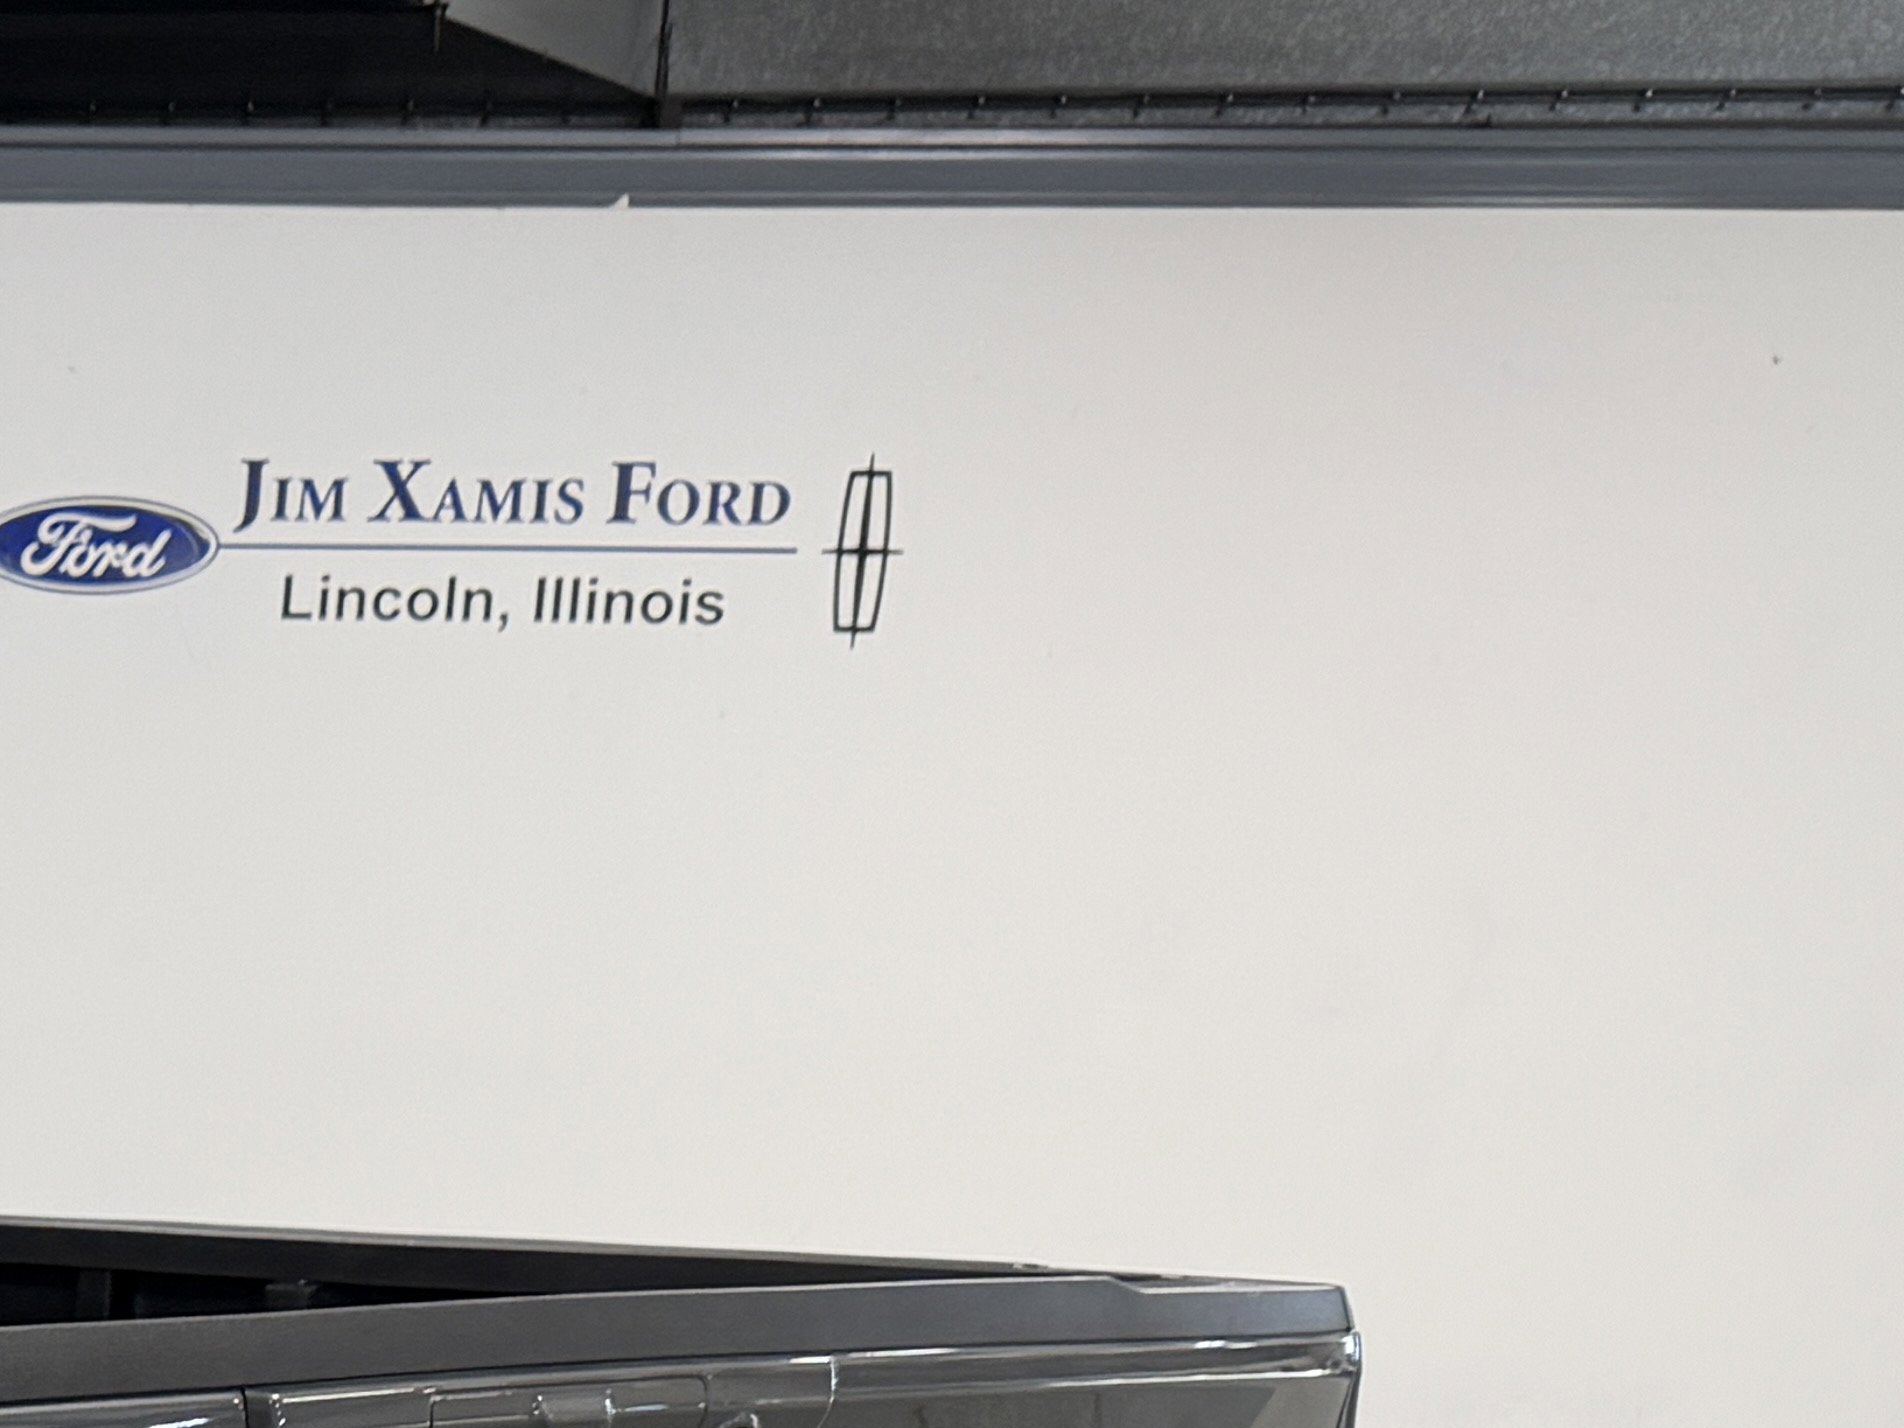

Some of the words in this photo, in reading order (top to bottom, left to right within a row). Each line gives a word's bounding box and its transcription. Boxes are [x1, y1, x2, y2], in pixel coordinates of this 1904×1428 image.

[233, 457, 346, 533] JIM
[368, 458, 584, 526] XAMIS
[605, 460, 793, 527] FORD
[19, 511, 167, 580] Ford
[280, 574, 510, 632] Lincoln,
[532, 576, 726, 626] Illinois
